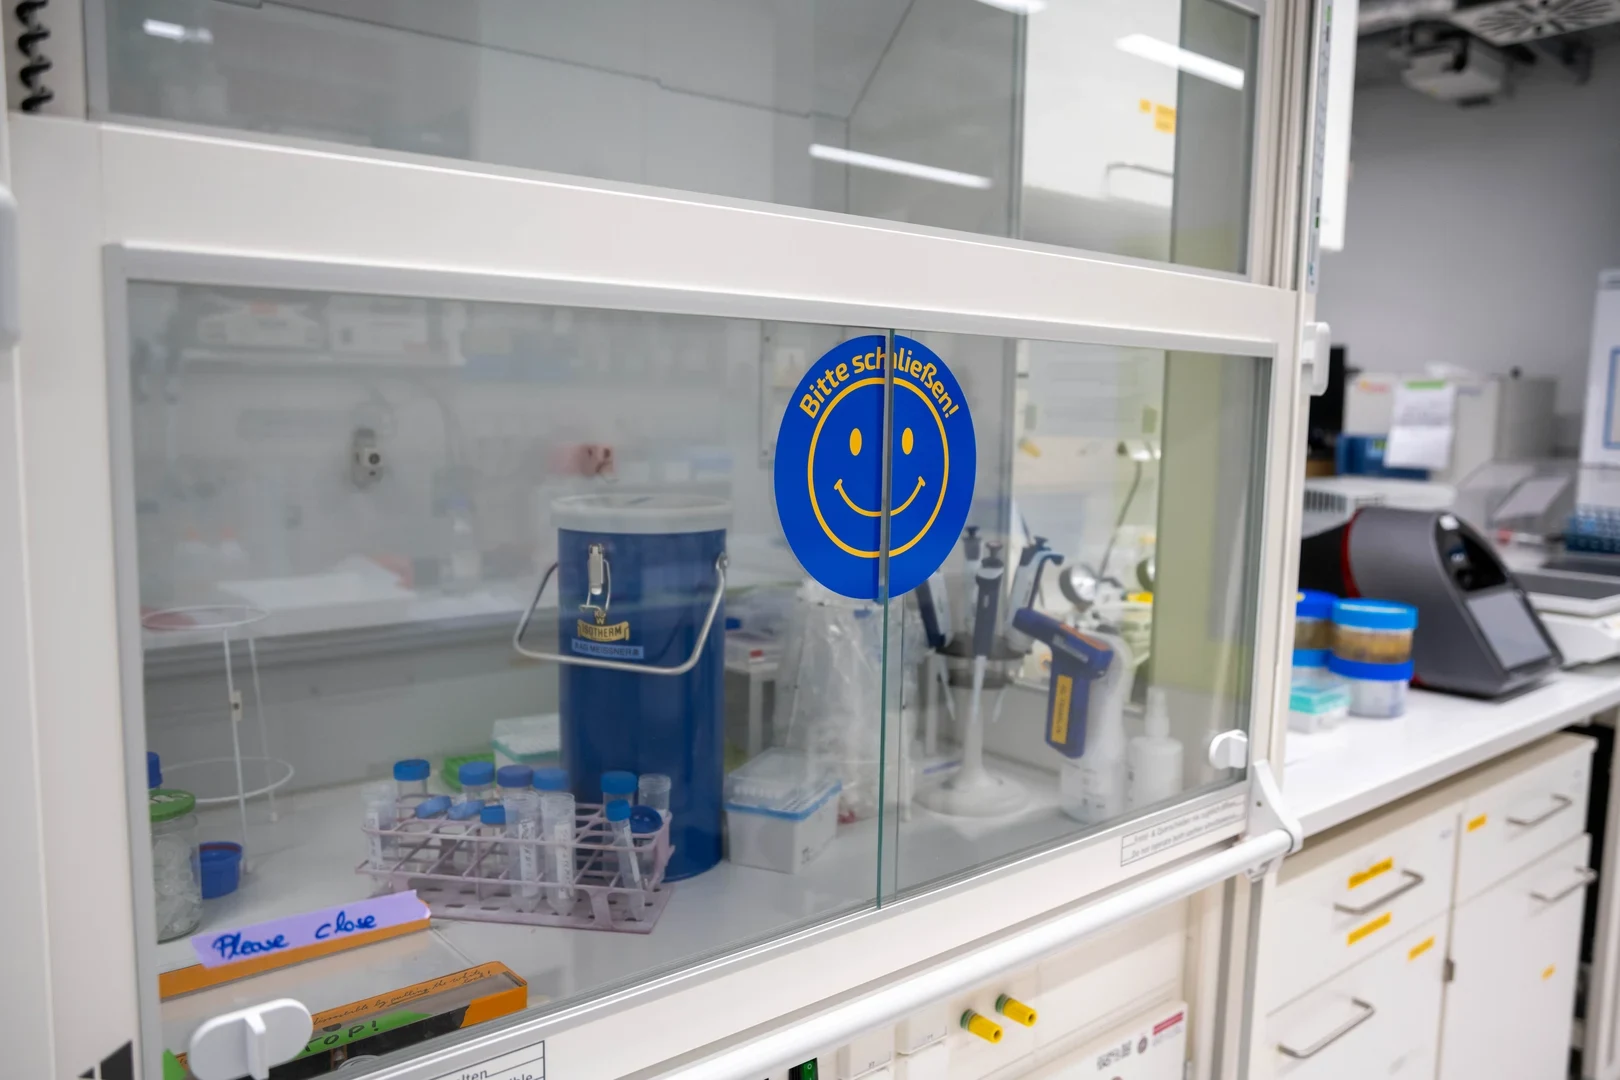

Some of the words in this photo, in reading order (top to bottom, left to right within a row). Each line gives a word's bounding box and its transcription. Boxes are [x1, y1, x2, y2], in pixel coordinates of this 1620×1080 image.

[799, 362, 850, 419] Bitte
[852, 346, 959, 418] schließen!
[581, 623, 622, 638] ISOTHERM
[212, 931, 289, 960] Please
[315, 910, 377, 940] close
[374, 999, 386, 1009] by
[391, 987, 429, 1004] pulling
[432, 979, 447, 990] the
